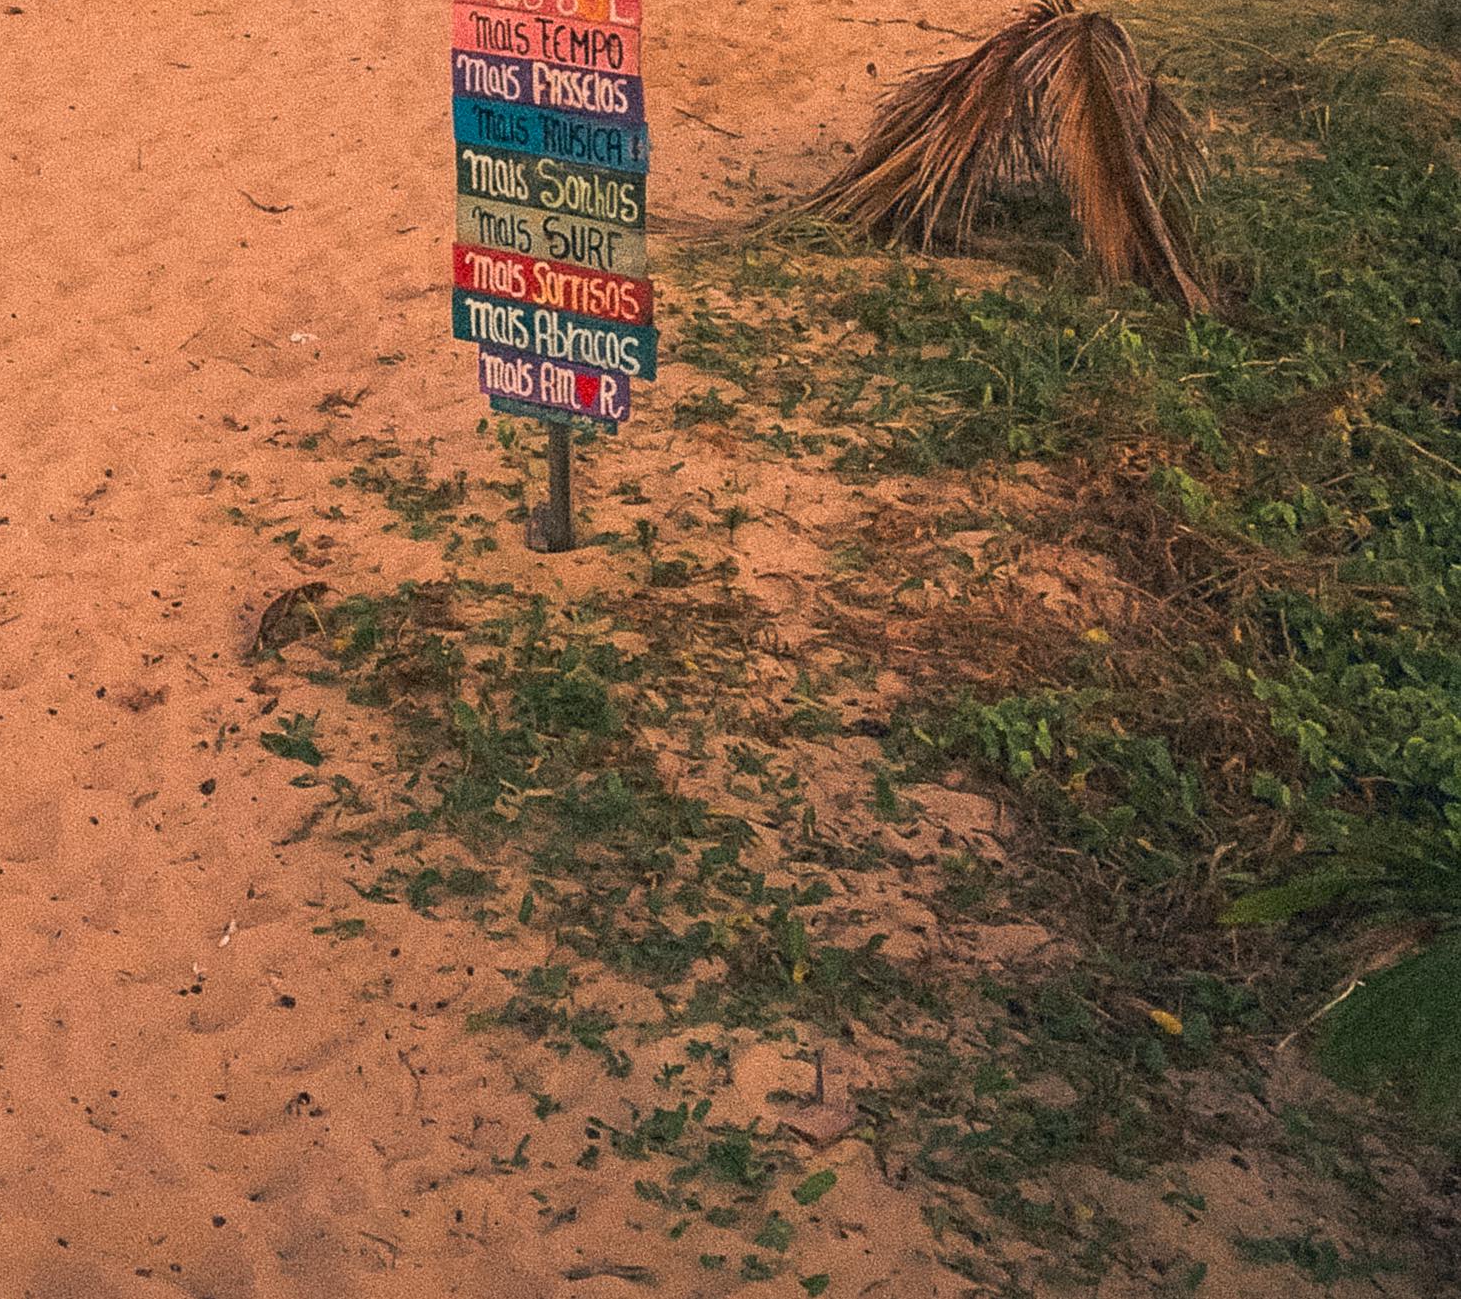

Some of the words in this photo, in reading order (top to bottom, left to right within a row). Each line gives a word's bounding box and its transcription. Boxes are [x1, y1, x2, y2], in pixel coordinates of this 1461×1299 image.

[535, 17, 624, 69] TEMPO
[532, 61, 628, 113] PASSEIOS
[543, 216, 622, 270] SURF
